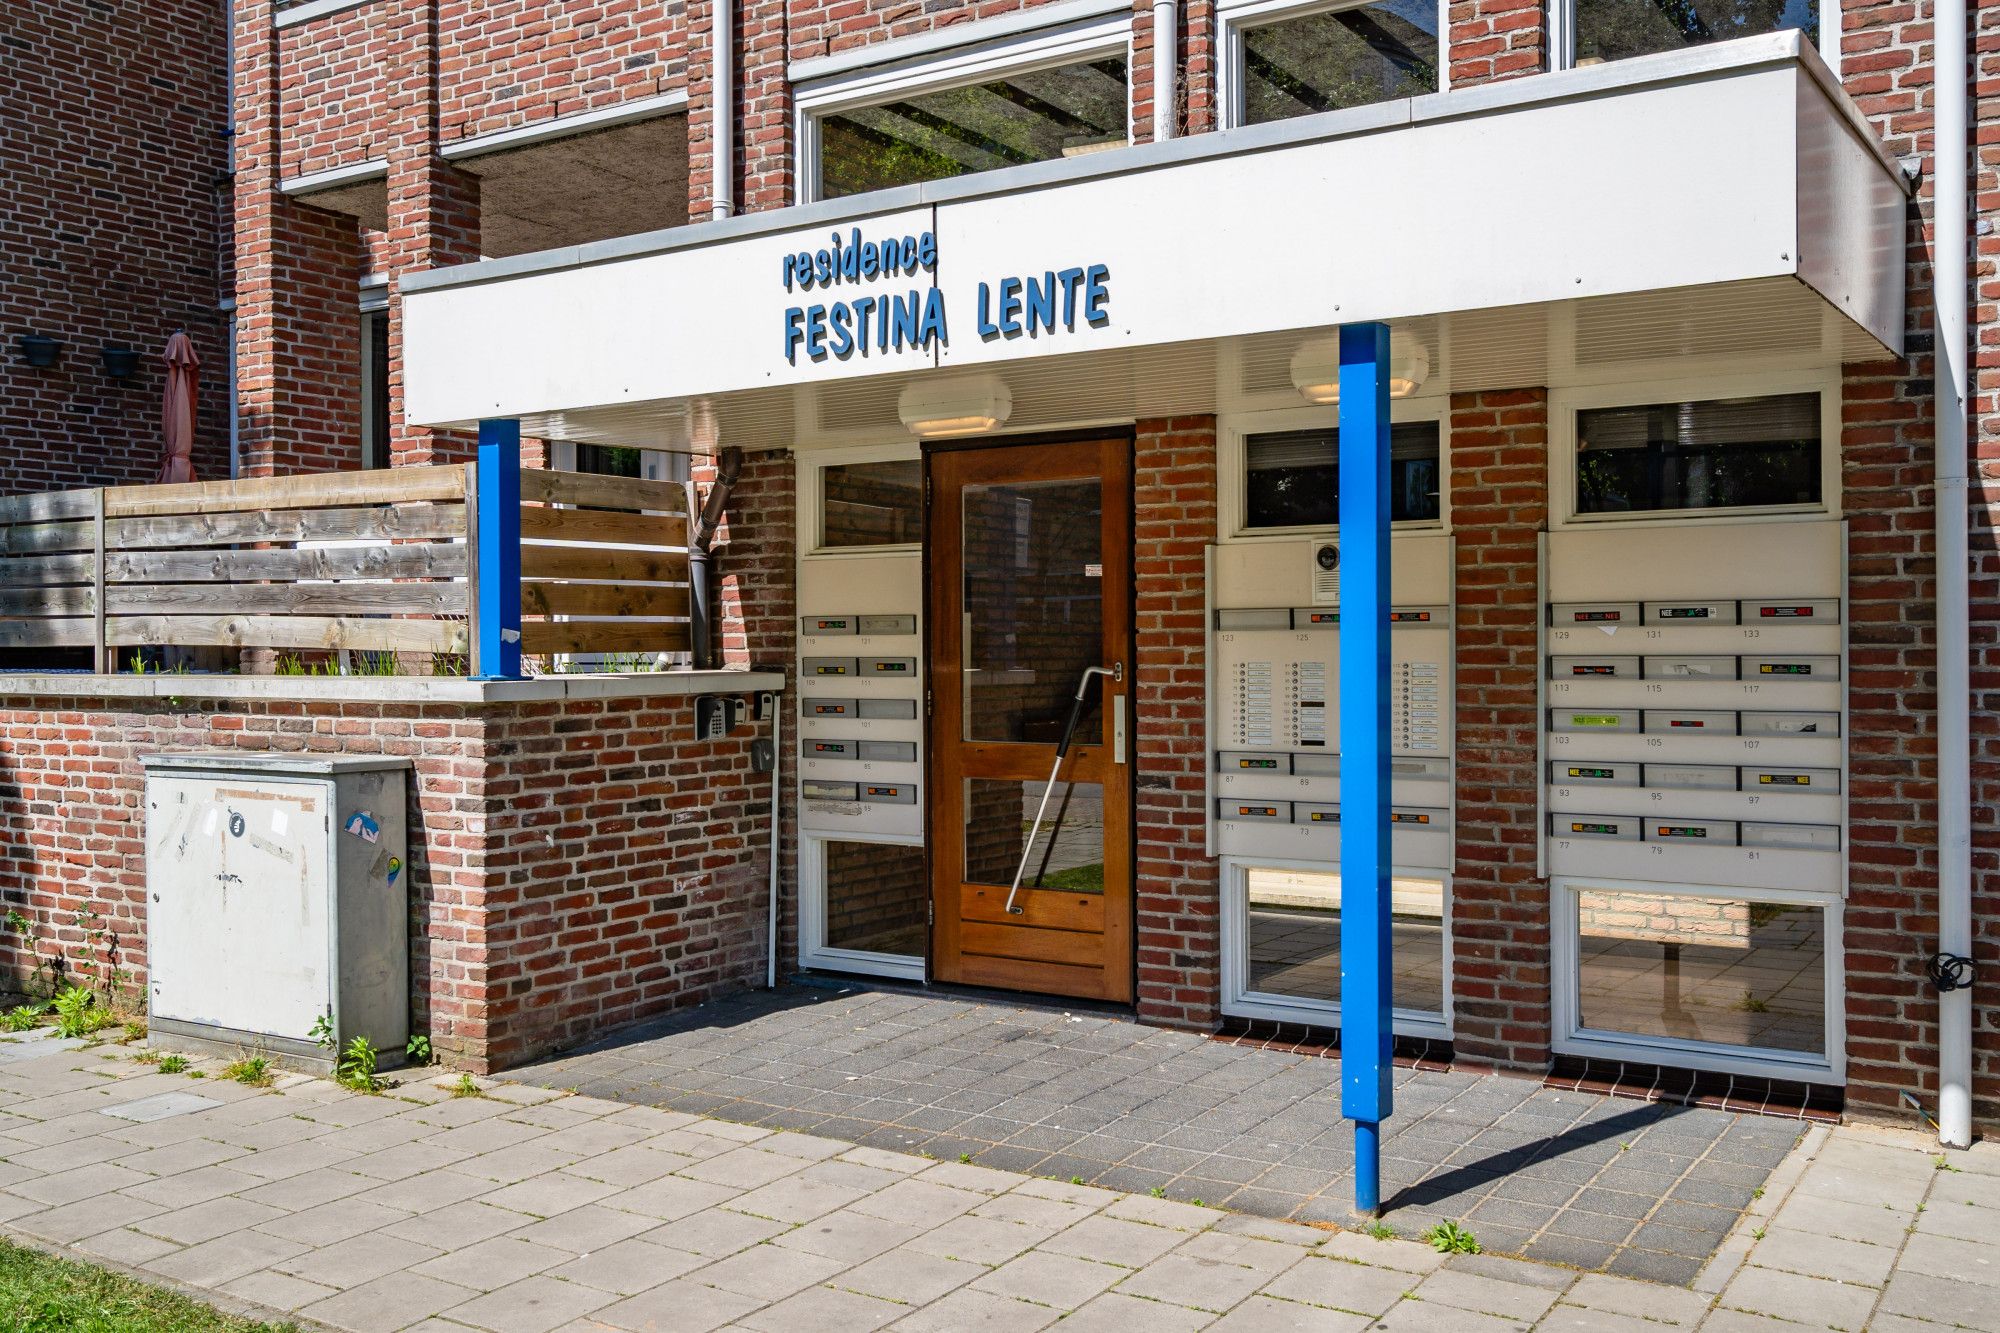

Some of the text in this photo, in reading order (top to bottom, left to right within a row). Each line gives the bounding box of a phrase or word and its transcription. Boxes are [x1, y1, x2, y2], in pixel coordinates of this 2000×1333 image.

[783, 227, 938, 289] residence
[784, 263, 1109, 360] FESTINA LENTE
[1604, 612, 1619, 620] NEE
[1661, 609, 1672, 617] NEE
[1554, 631, 1569, 639] 129
[1646, 630, 1661, 638] 131
[1743, 630, 1760, 638] 133
[1554, 684, 1569, 692] 113
[1646, 684, 1662, 692] 115
[1743, 685, 1760, 693] 117
[1646, 738, 1662, 747] 105
[1744, 740, 1760, 749] 107
[1797, 776, 1809, 784] NEE
[1559, 789, 1570, 797] 93
[1651, 793, 1662, 801] 95
[1748, 796, 1760, 804] 97
[1300, 828, 1310, 836] 73
[1559, 841, 1570, 849] 77
[1652, 846, 1663, 855] 79
[1748, 851, 1760, 860] 81
